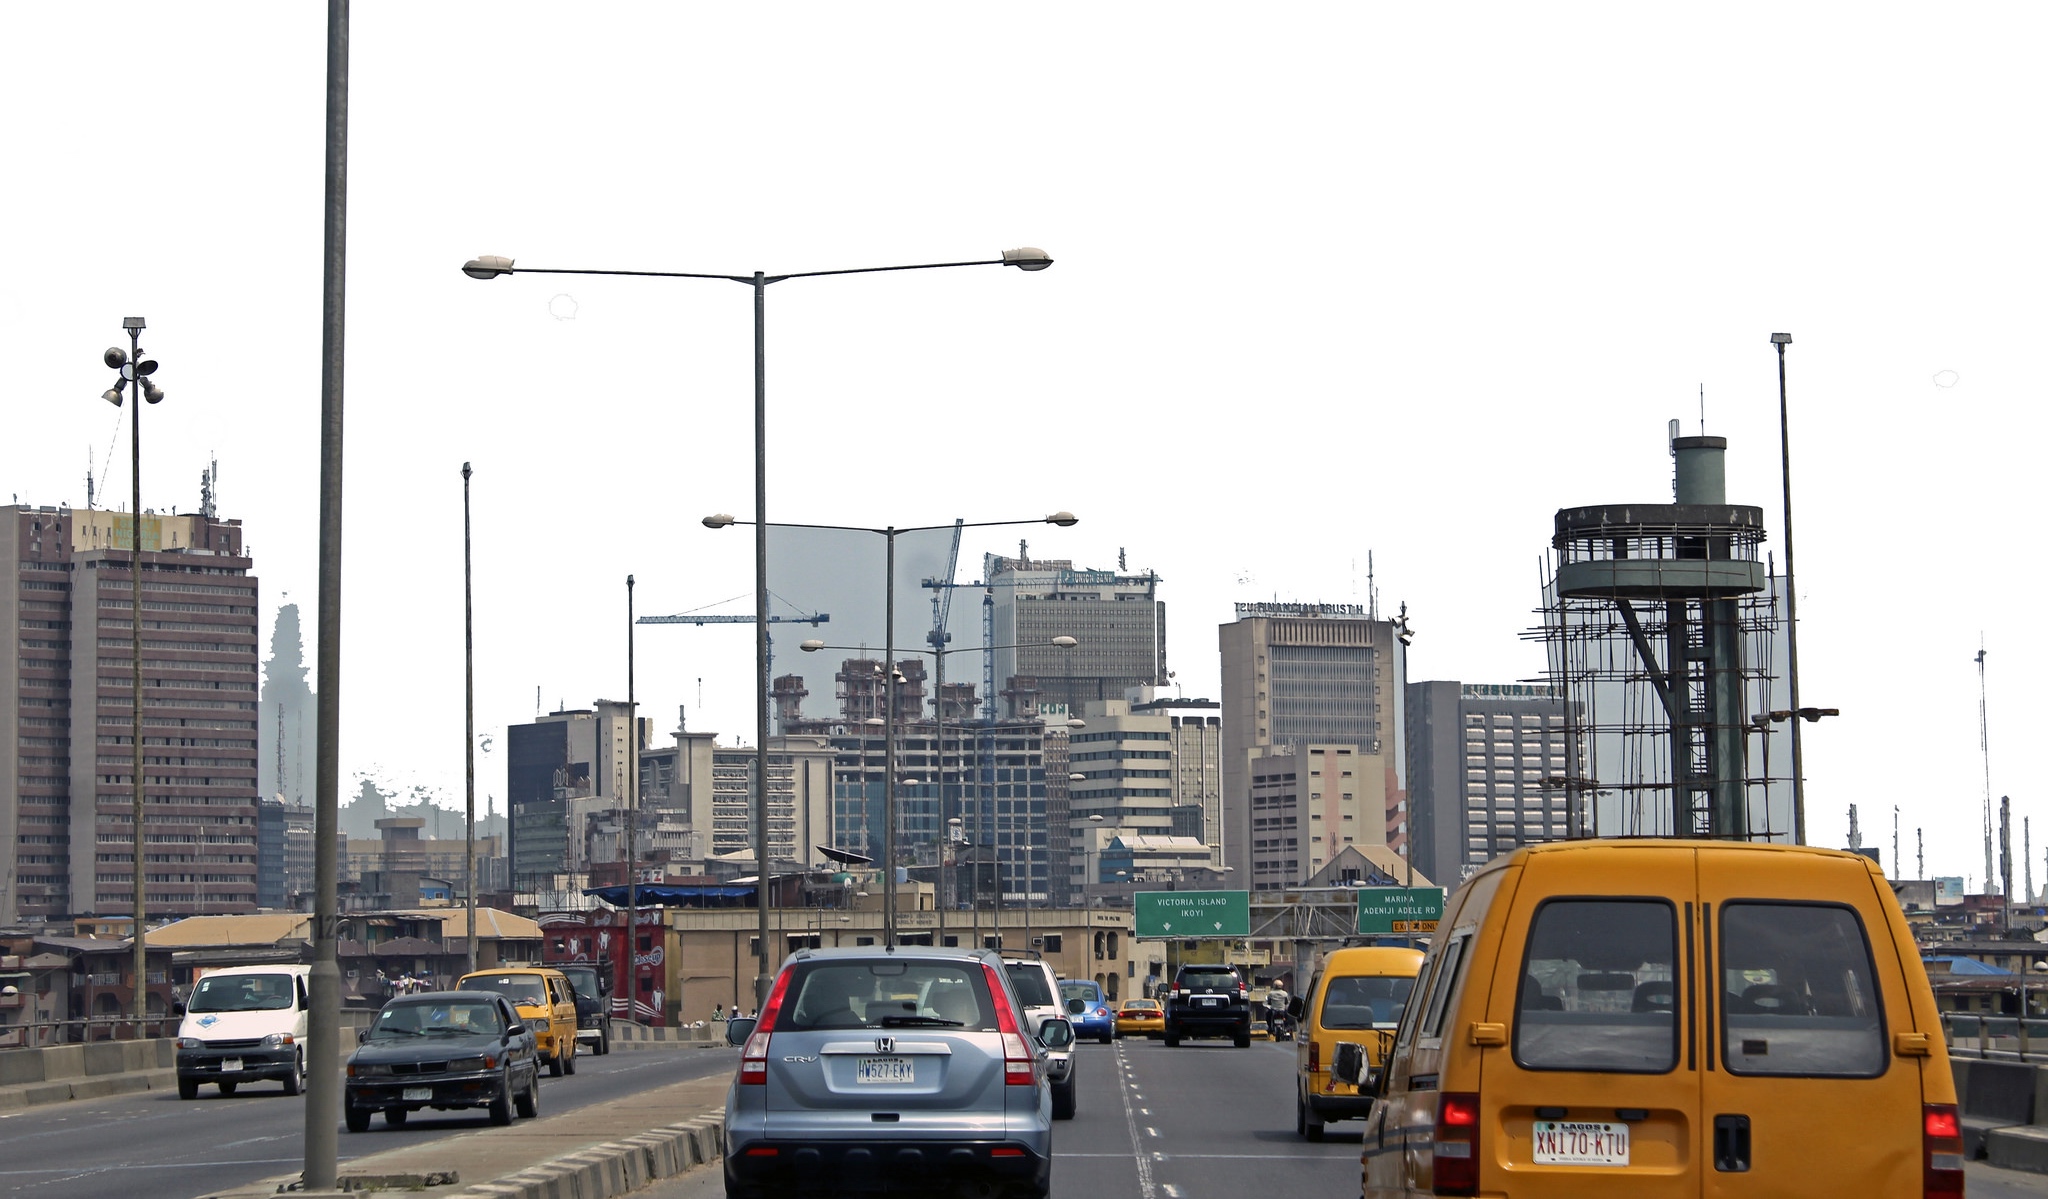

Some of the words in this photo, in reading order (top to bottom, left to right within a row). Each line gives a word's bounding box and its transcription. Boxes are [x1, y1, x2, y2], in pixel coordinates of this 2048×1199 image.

[115, 529, 160, 540] NIGRIA
[117, 538, 155, 549] HOSE
[1074, 573, 1094, 584] UNION
[1157, 898, 1194, 906] VICTORIA
[1197, 898, 1227, 906] ISLAND
[1384, 895, 1415, 903] MARINA
[1181, 909, 1204, 917] IKOYI
[1363, 907, 1395, 915] ADENIJI
[1425, 906, 1436, 914] RD
[318, 914, 335, 940] 12
[783, 1055, 818, 1063] CR-V
[1560, 1123, 1601, 1131] LAGOS
[1537, 1131, 1625, 1156] XN170-KTU
